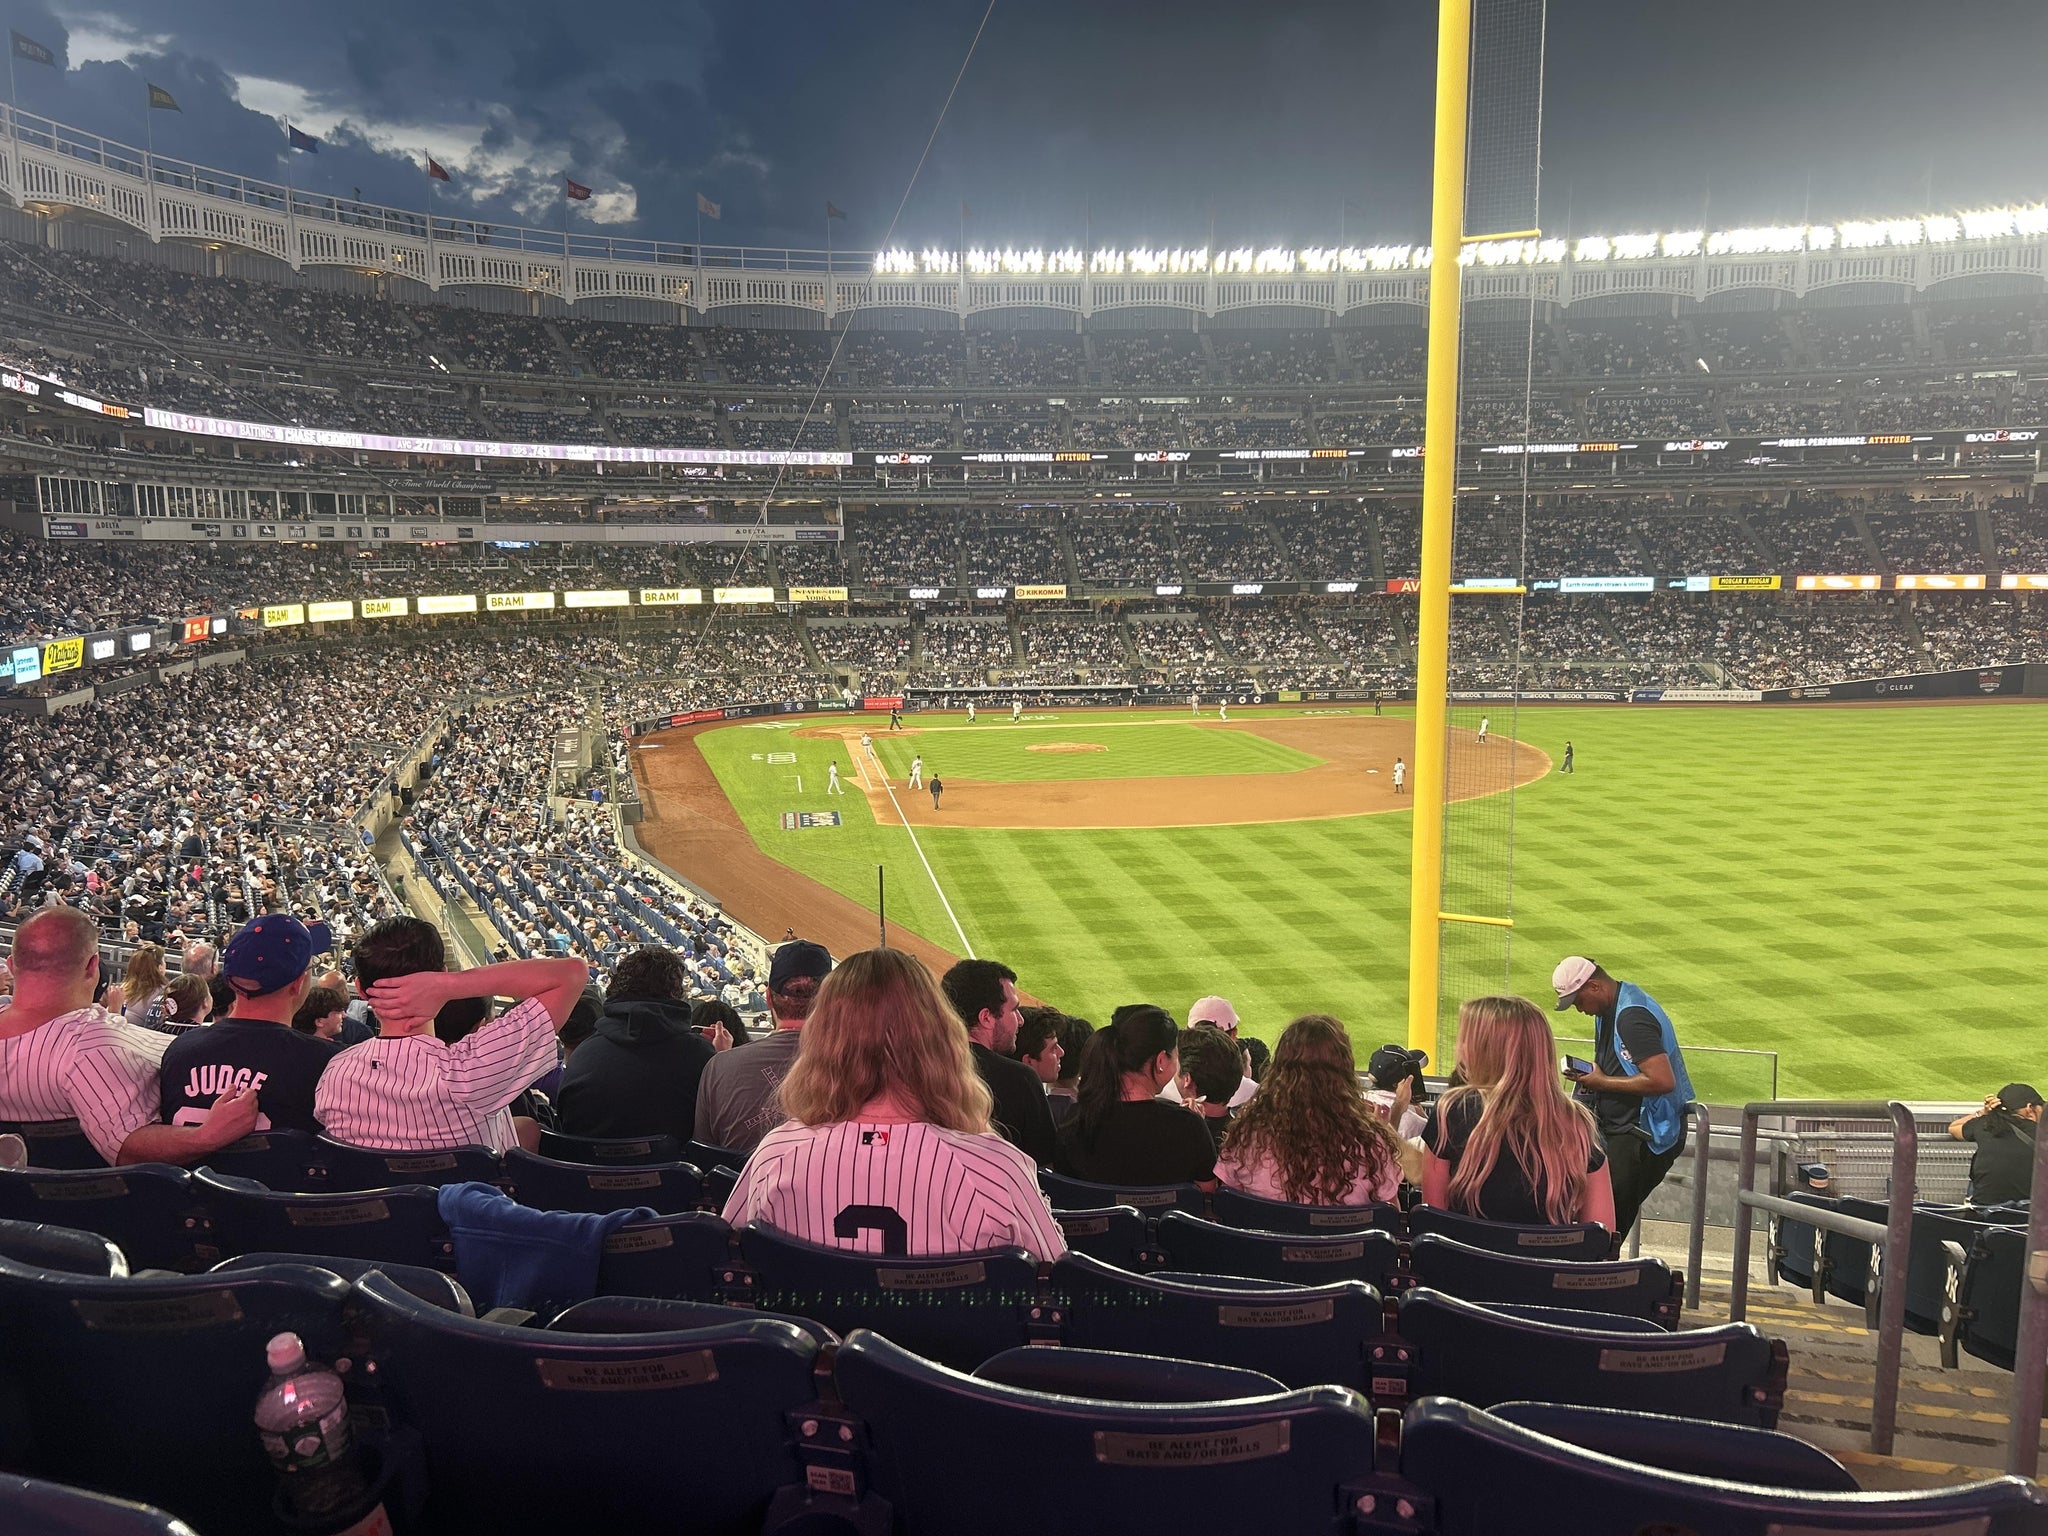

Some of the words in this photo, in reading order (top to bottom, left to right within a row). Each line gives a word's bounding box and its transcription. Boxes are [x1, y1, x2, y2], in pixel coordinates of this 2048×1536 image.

[1470, 402, 1505, 410] ASPEN
[1966, 433, 1995, 442] BAD
[2009, 432, 2039, 440] BOY
[397, 440, 412, 449] AVG
[1665, 442, 1691, 451] BAD
[1703, 441, 1728, 450] BOY
[1135, 453, 1156, 462] BAD
[1168, 453, 1190, 461] BOY
[1392, 448, 1415, 457] BAD
[876, 455, 898, 464] BAD
[910, 455, 932, 464] BOY
[388, 479, 422, 487] 27-Time
[425, 480, 449, 488] World
[451, 480, 492, 491] Champions
[491, 596, 524, 607] BRAMI
[645, 592, 679, 602] BRAMI
[366, 602, 391, 614] BRAMI
[268, 609, 288, 623] BRAMI
[184, 1064, 269, 1097] JUDGE
[1768, 1219, 1776, 1246] NY
[1814, 1227, 1823, 1257] NY
[1870, 1243, 1881, 1276] NY
[946, 1274, 969, 1283] BALLS
[1944, 1264, 1959, 1303] NY
[1292, 1313, 1316, 1321] BALLS
[1681, 1358, 1706, 1366] BALLS
[584, 1367, 596, 1376] BE
[603, 1366, 638, 1376] ALERT
[642, 1364, 666, 1374] FOR
[568, 1375, 597, 1384] BATS
[651, 1369, 690, 1382] BALLS
[1148, 1440, 1164, 1450] BE
[1169, 1439, 1208, 1449] ALERT
[1213, 1436, 1238, 1446] FOR
[1126, 1449, 1159, 1459] BATS
[1220, 1441, 1261, 1456] BALLS
